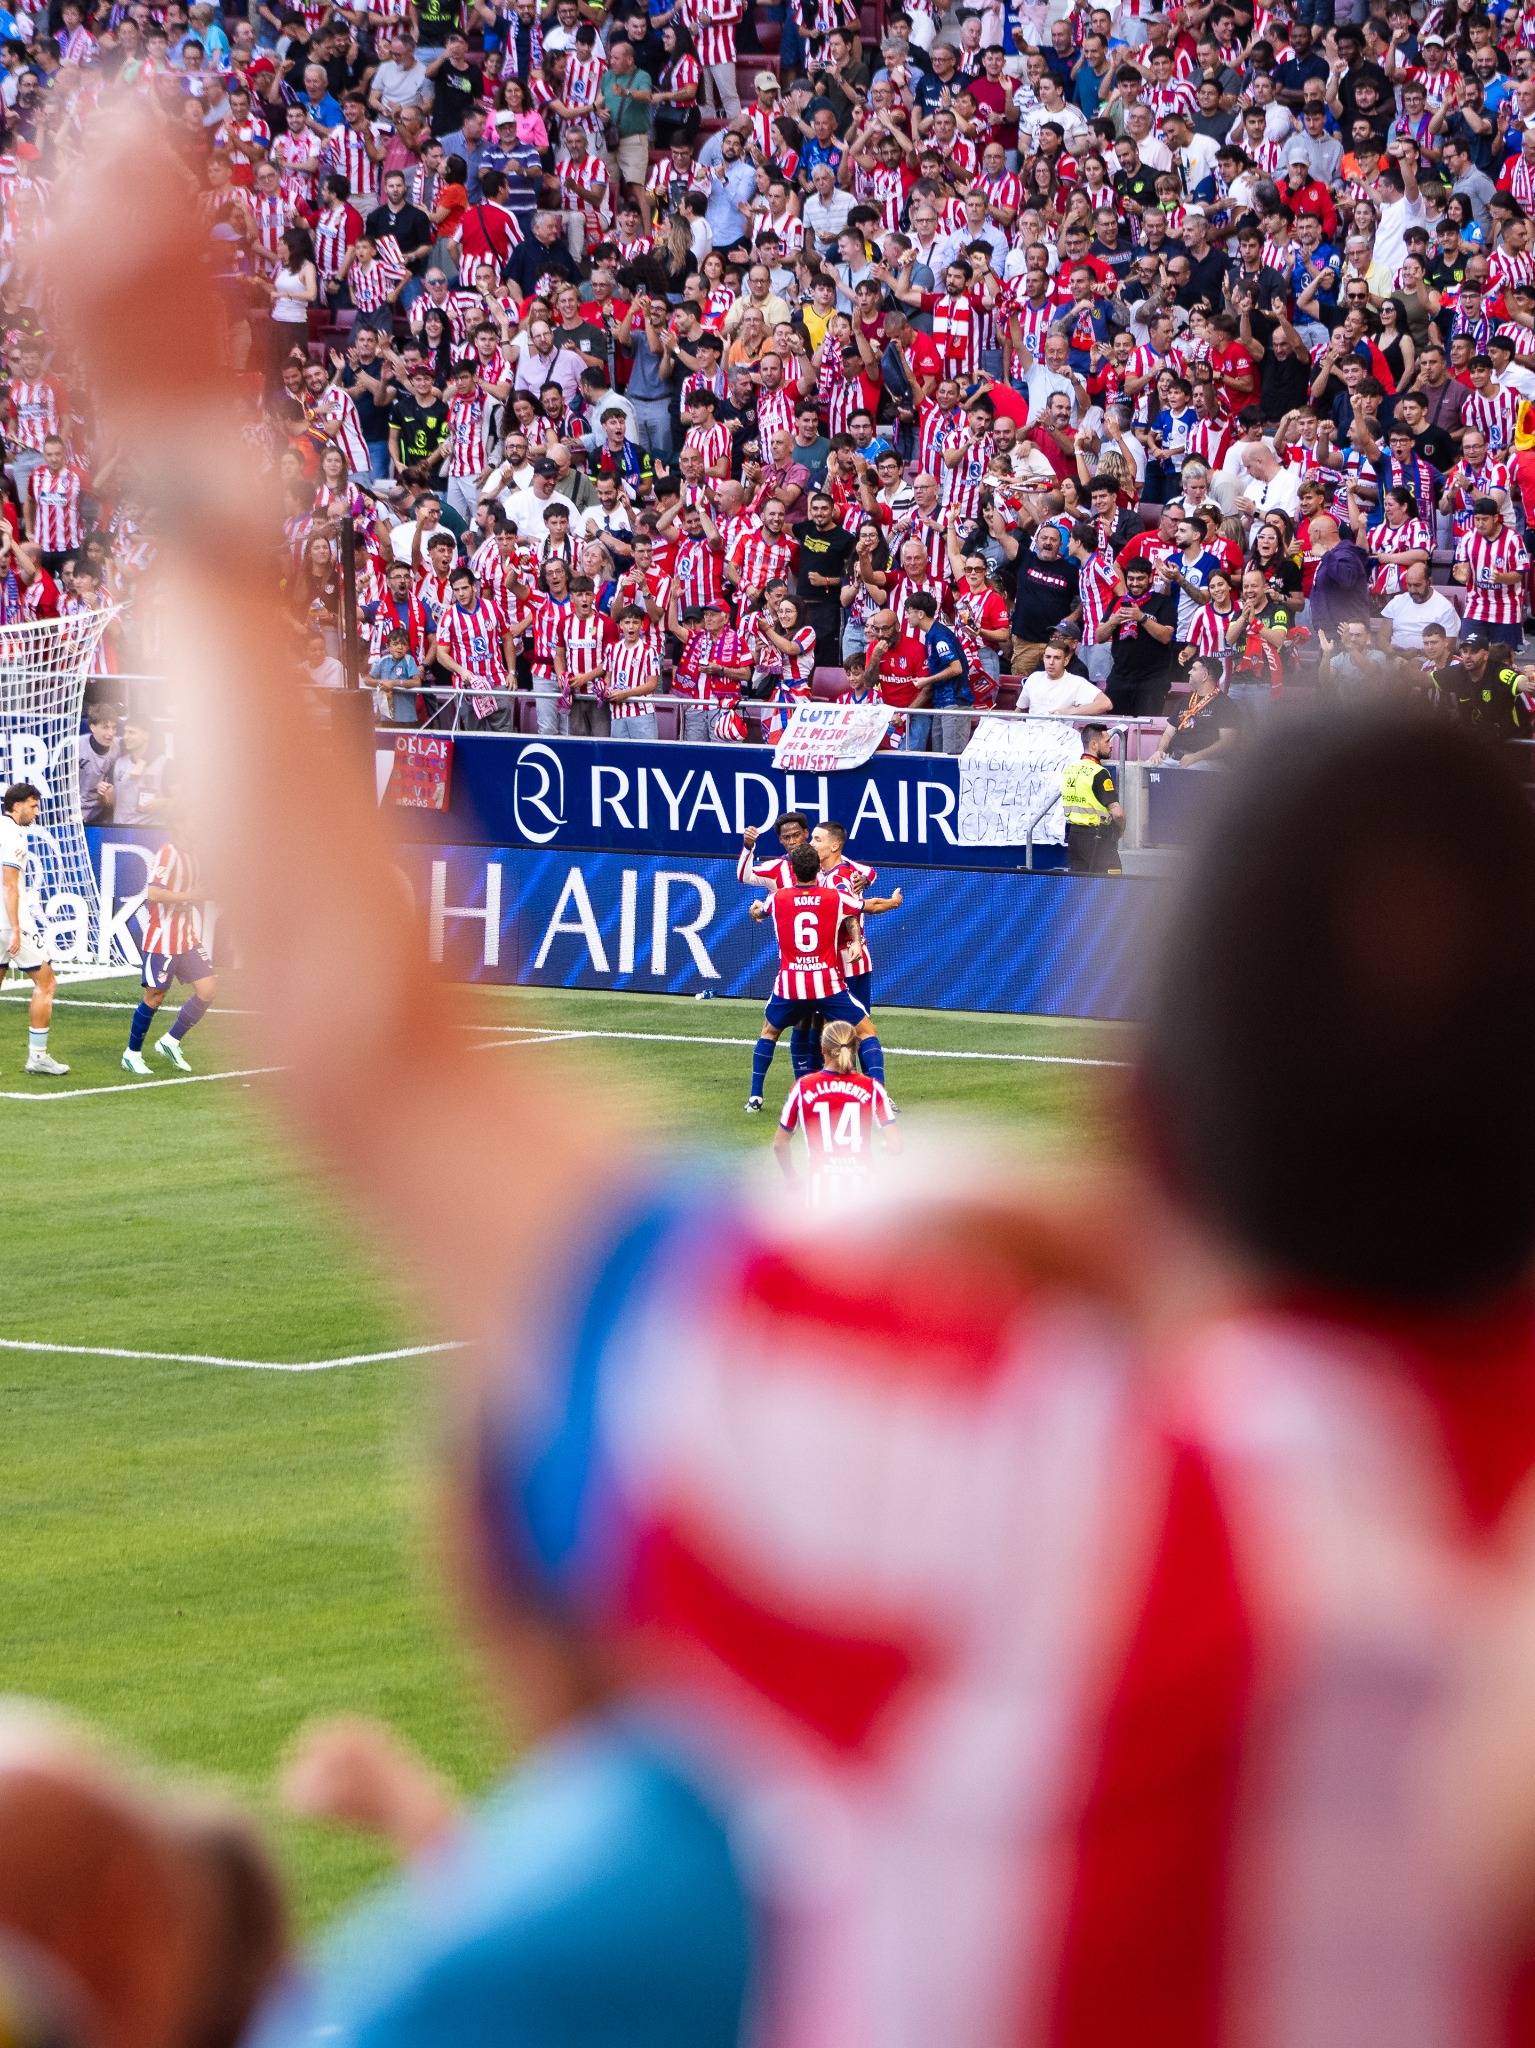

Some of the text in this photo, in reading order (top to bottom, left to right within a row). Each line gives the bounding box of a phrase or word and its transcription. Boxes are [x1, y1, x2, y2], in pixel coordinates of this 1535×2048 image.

[800, 708, 840, 725] CUTI
[793, 727, 807, 738] EL
[396, 737, 447, 758] OBLAK
[591, 766, 828, 836] RIYADH
[849, 780, 959, 845] AIR
[794, 896, 821, 906] KOKE
[534, 867, 721, 979] AIR
[794, 911, 819, 953] 6
[163, 954, 172, 971] 7
[788, 962, 828, 971] RWANDA
[803, 1080, 872, 1104] M. LLORENTE
[813, 1101, 862, 1152] 14
